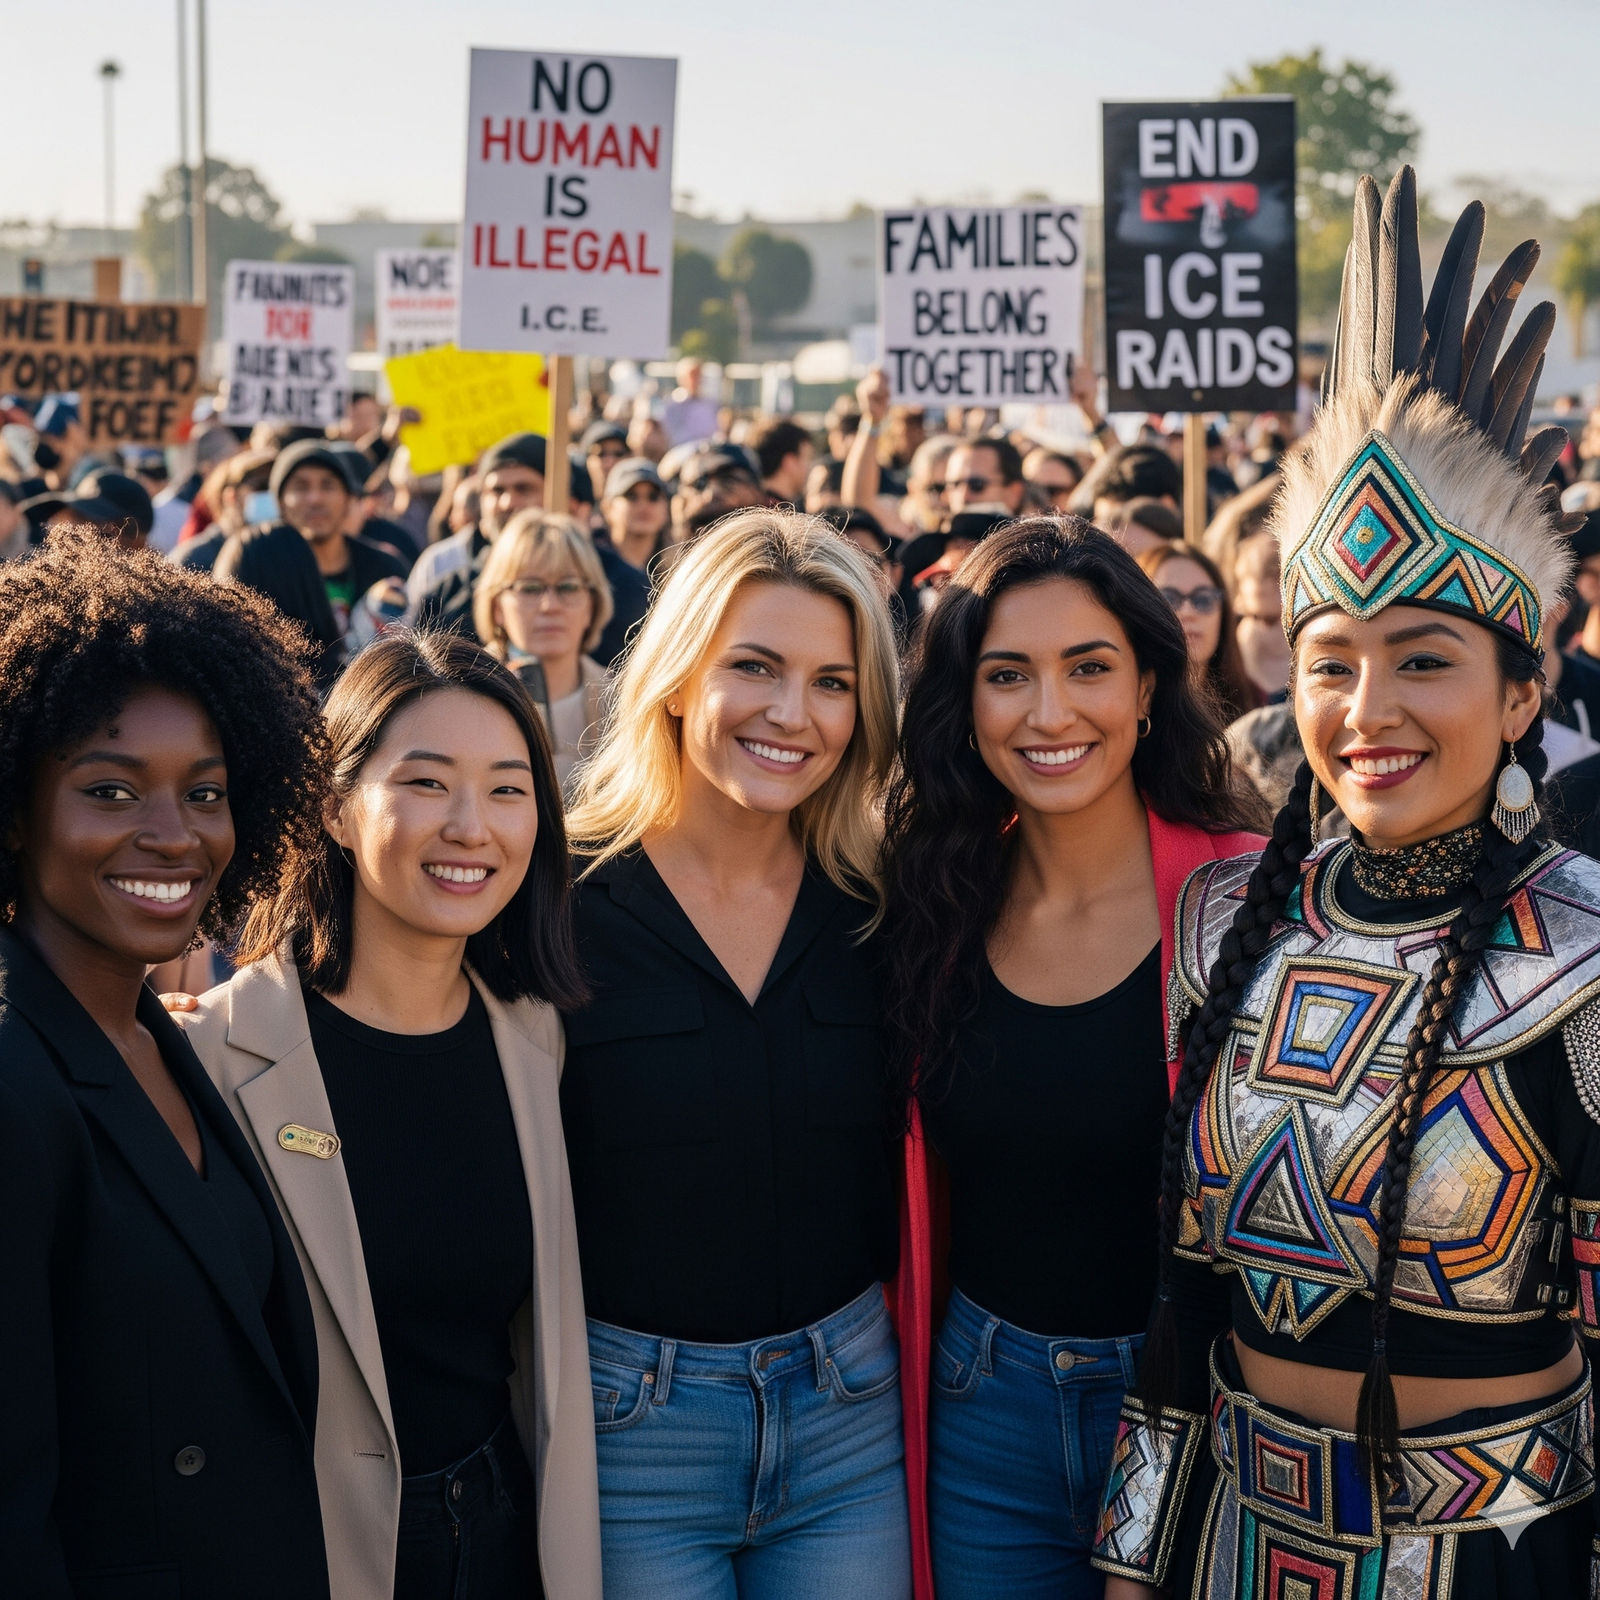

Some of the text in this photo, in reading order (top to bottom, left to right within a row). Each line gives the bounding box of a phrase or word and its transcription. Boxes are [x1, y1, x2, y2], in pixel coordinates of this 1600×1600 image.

[530, 56, 612, 115] NO
[481, 116, 661, 170] HUMAN
[1138, 117, 1260, 178] END
[544, 173, 588, 219] IS
[471, 223, 661, 277] ILLEGAL
[884, 211, 1078, 273] FAMILIES
[913, 287, 1047, 337] BELONG
[1143, 251, 1265, 320] ICE
[520, 304, 607, 334] I.C.E.
[1115, 325, 1295, 390] RAIDS
